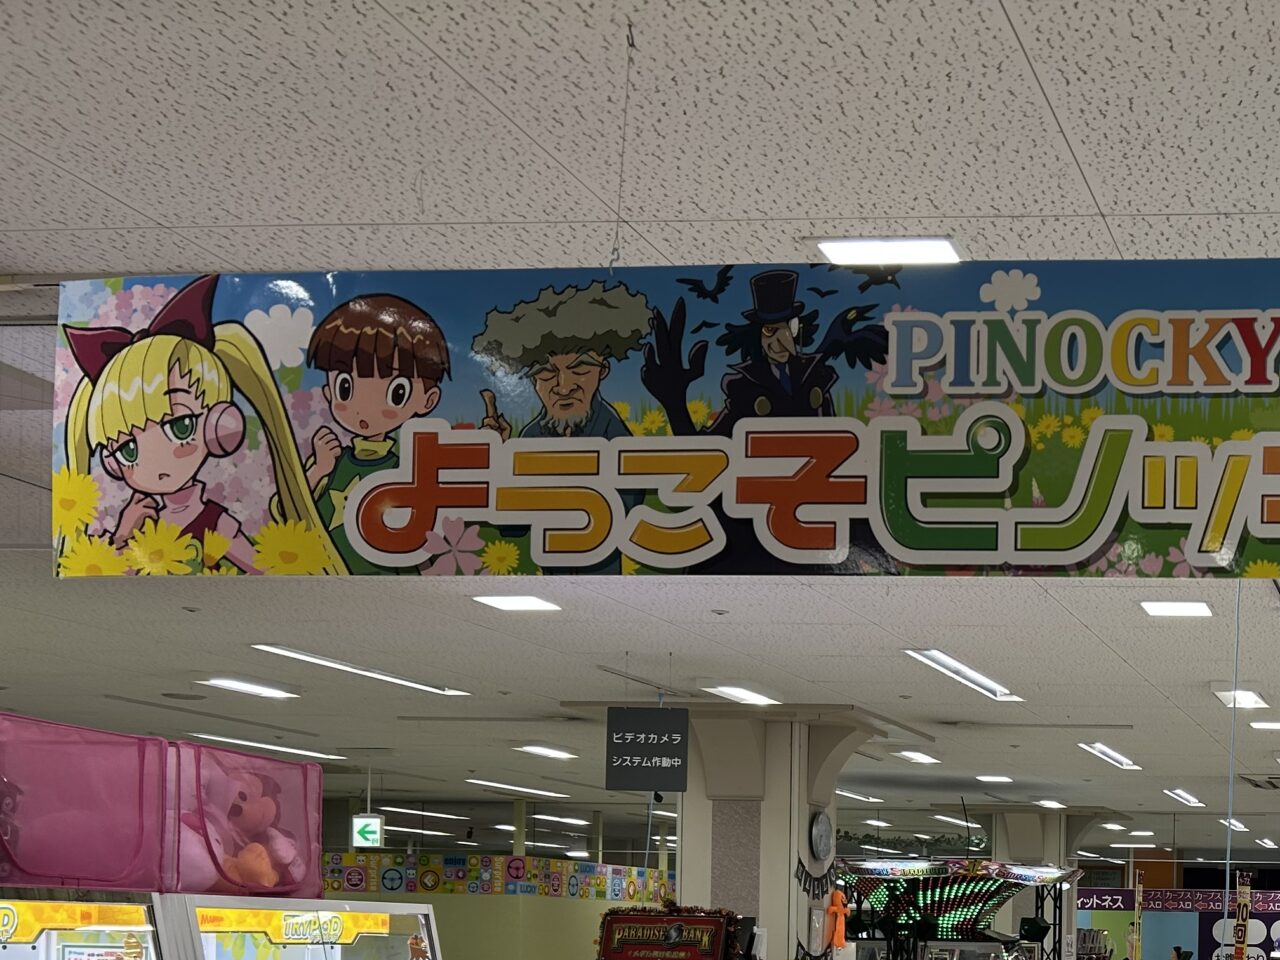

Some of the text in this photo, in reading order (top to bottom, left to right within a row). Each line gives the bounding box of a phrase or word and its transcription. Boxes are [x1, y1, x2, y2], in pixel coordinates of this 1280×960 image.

[612, 732, 682, 744] ビデオカメラ
[612, 756, 682, 768] システム作動中
[1148, 901, 1162, 909] 入口
[1178, 901, 1192, 909] 入口
[1208, 902, 1222, 910] 入口
[615, 925, 714, 949] PARADISE BANK
